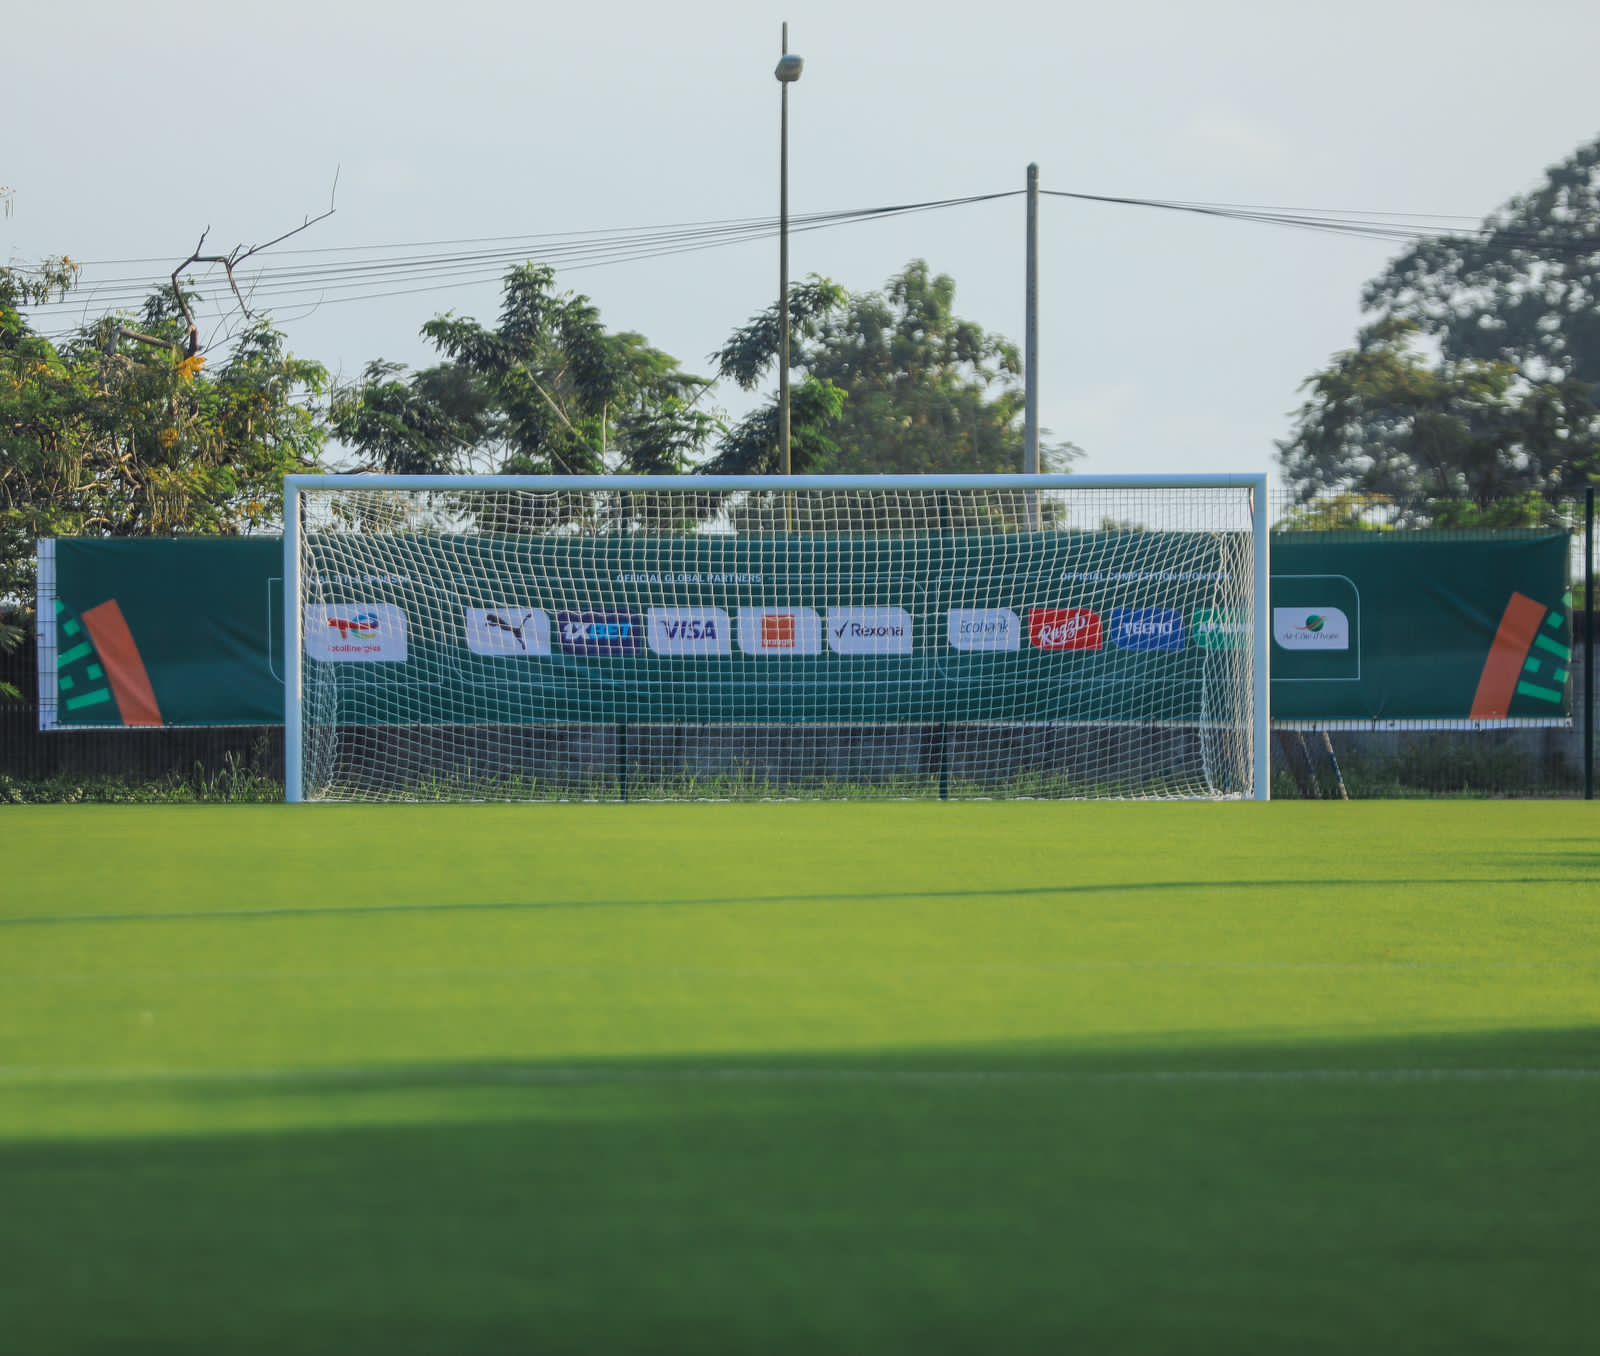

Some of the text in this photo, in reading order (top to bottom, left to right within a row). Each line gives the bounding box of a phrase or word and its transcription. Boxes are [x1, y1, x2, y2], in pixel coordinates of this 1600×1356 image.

[617, 574, 761, 584] OFFICIAL GLOBAL PARTNERS
[661, 620, 716, 639] VISA
[851, 623, 903, 637] Rexona
[960, 616, 1009, 633] Ecobank
